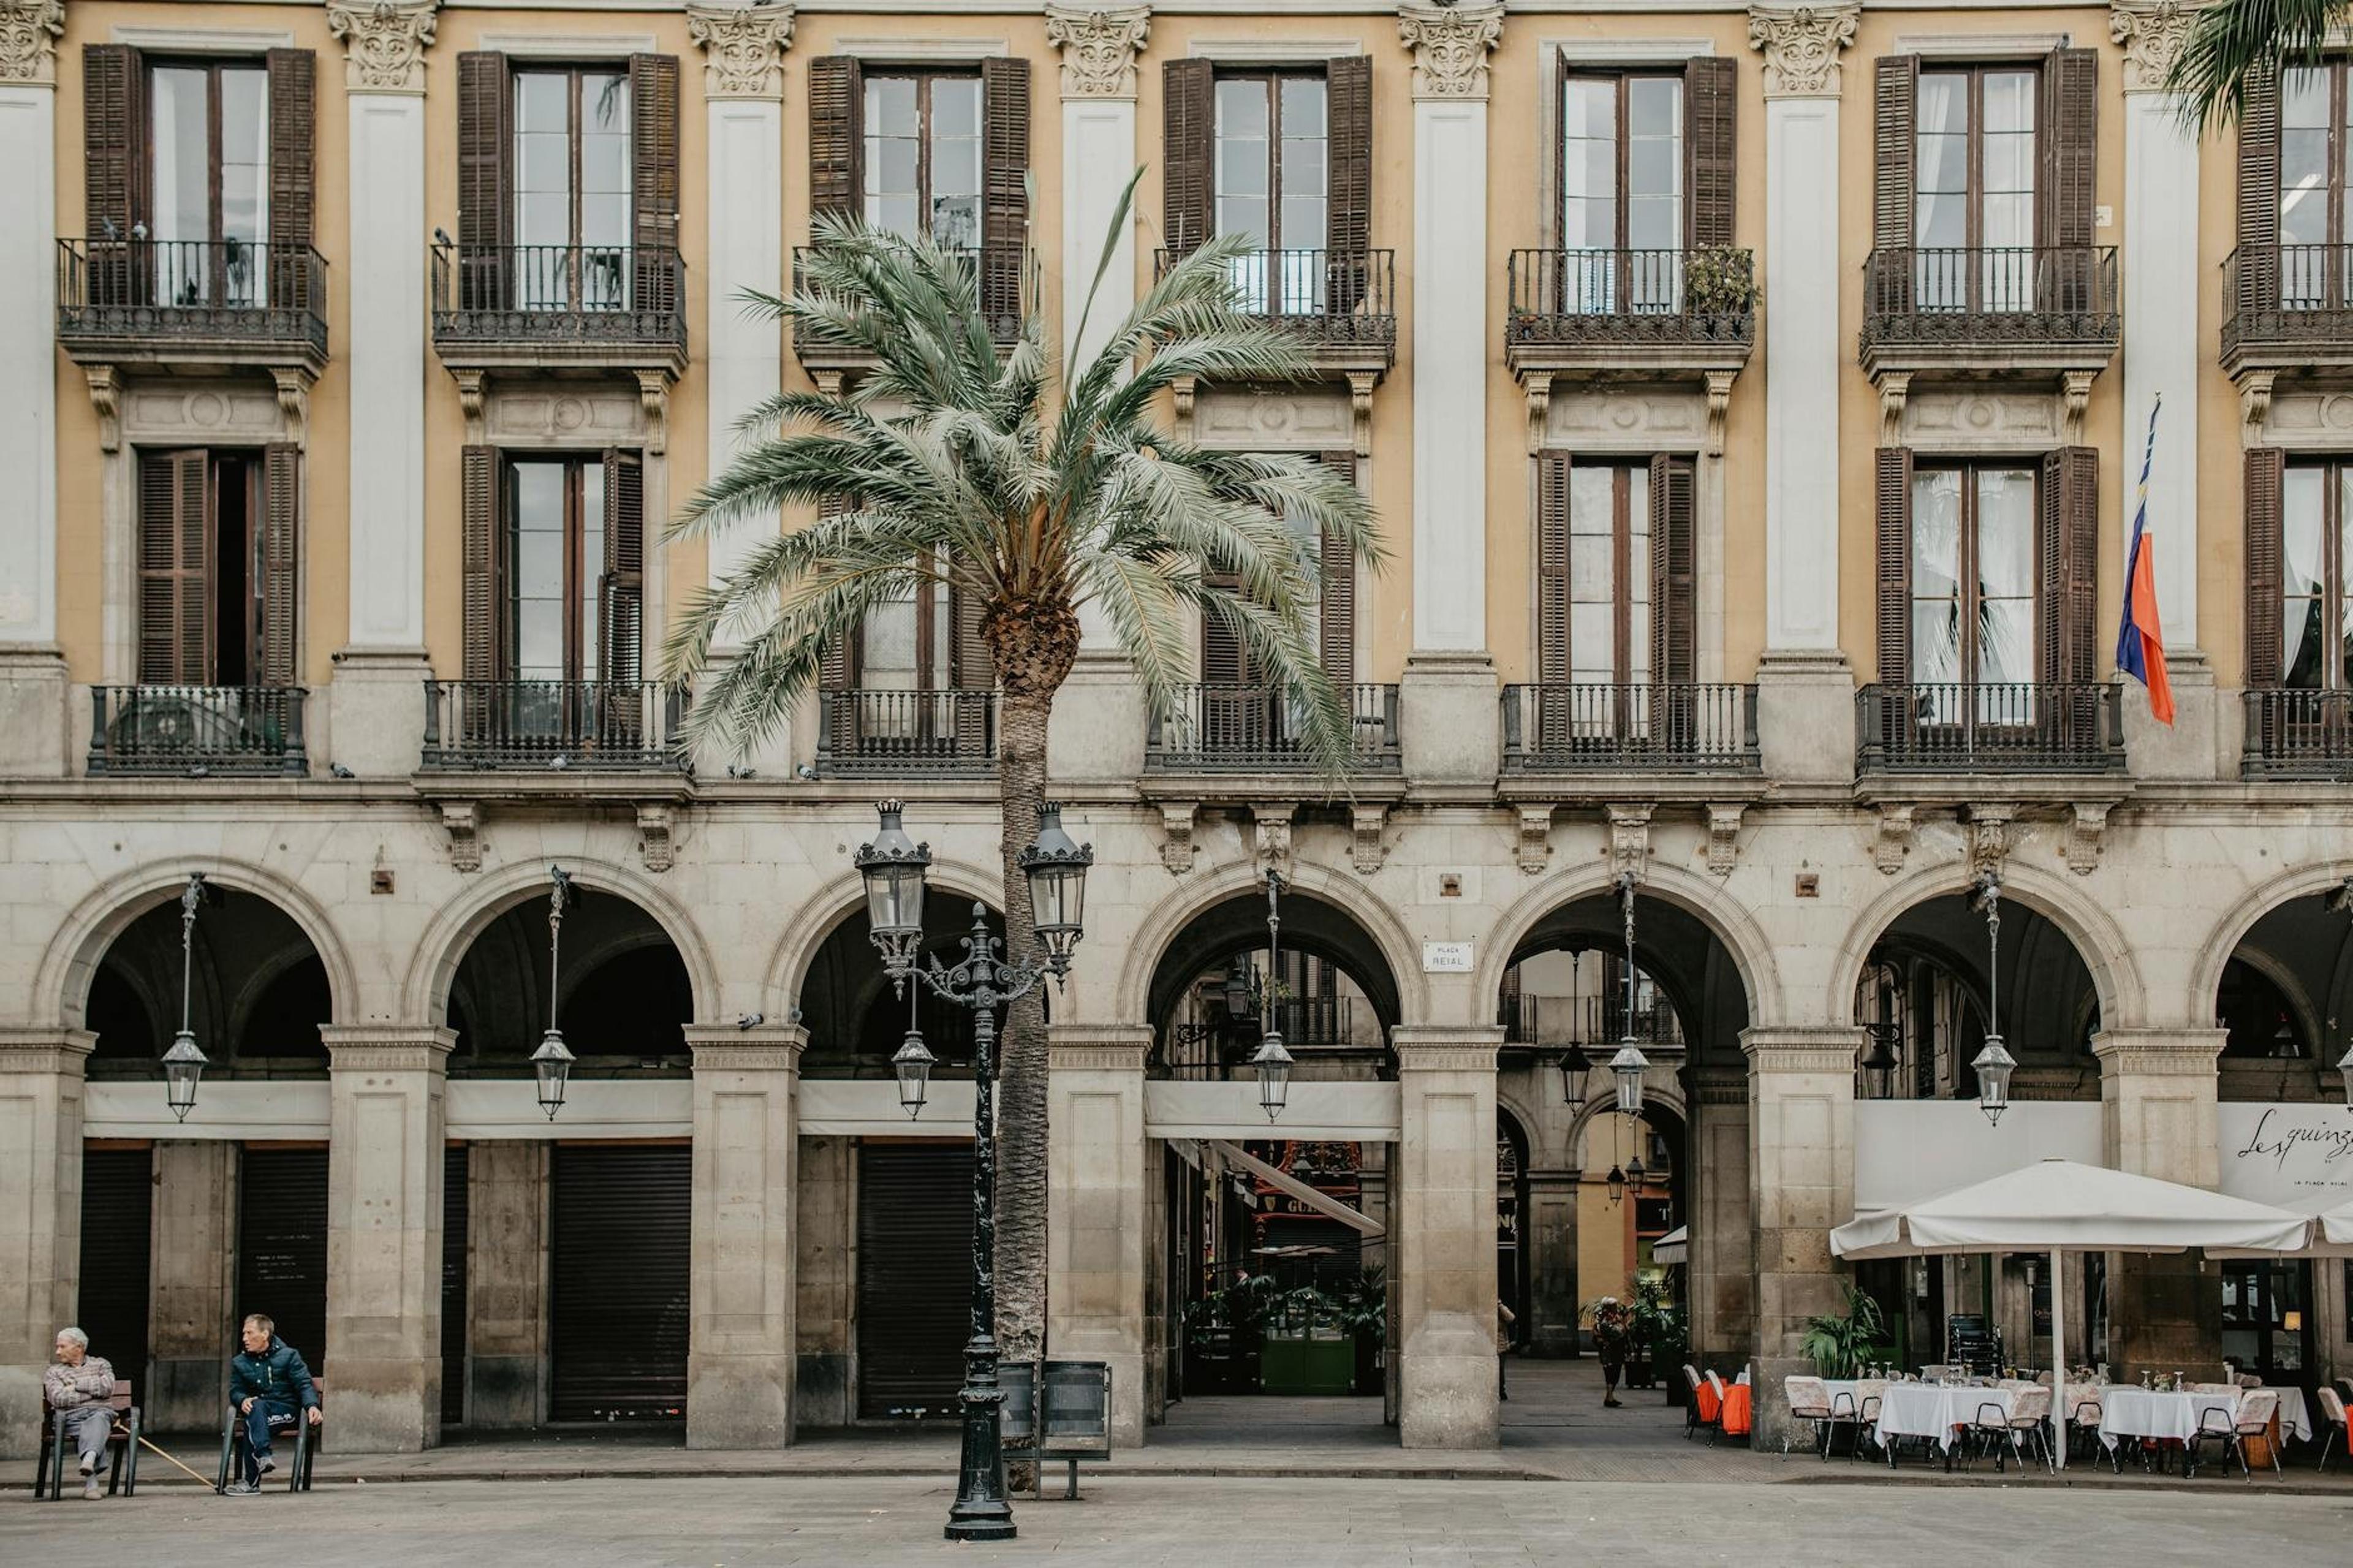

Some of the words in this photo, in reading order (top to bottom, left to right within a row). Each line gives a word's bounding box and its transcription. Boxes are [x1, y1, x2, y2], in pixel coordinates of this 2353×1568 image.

[1433, 956, 1463, 966] REIAL
[2238, 1108, 2284, 1158] Les
[2278, 1122, 2353, 1172] quinz
